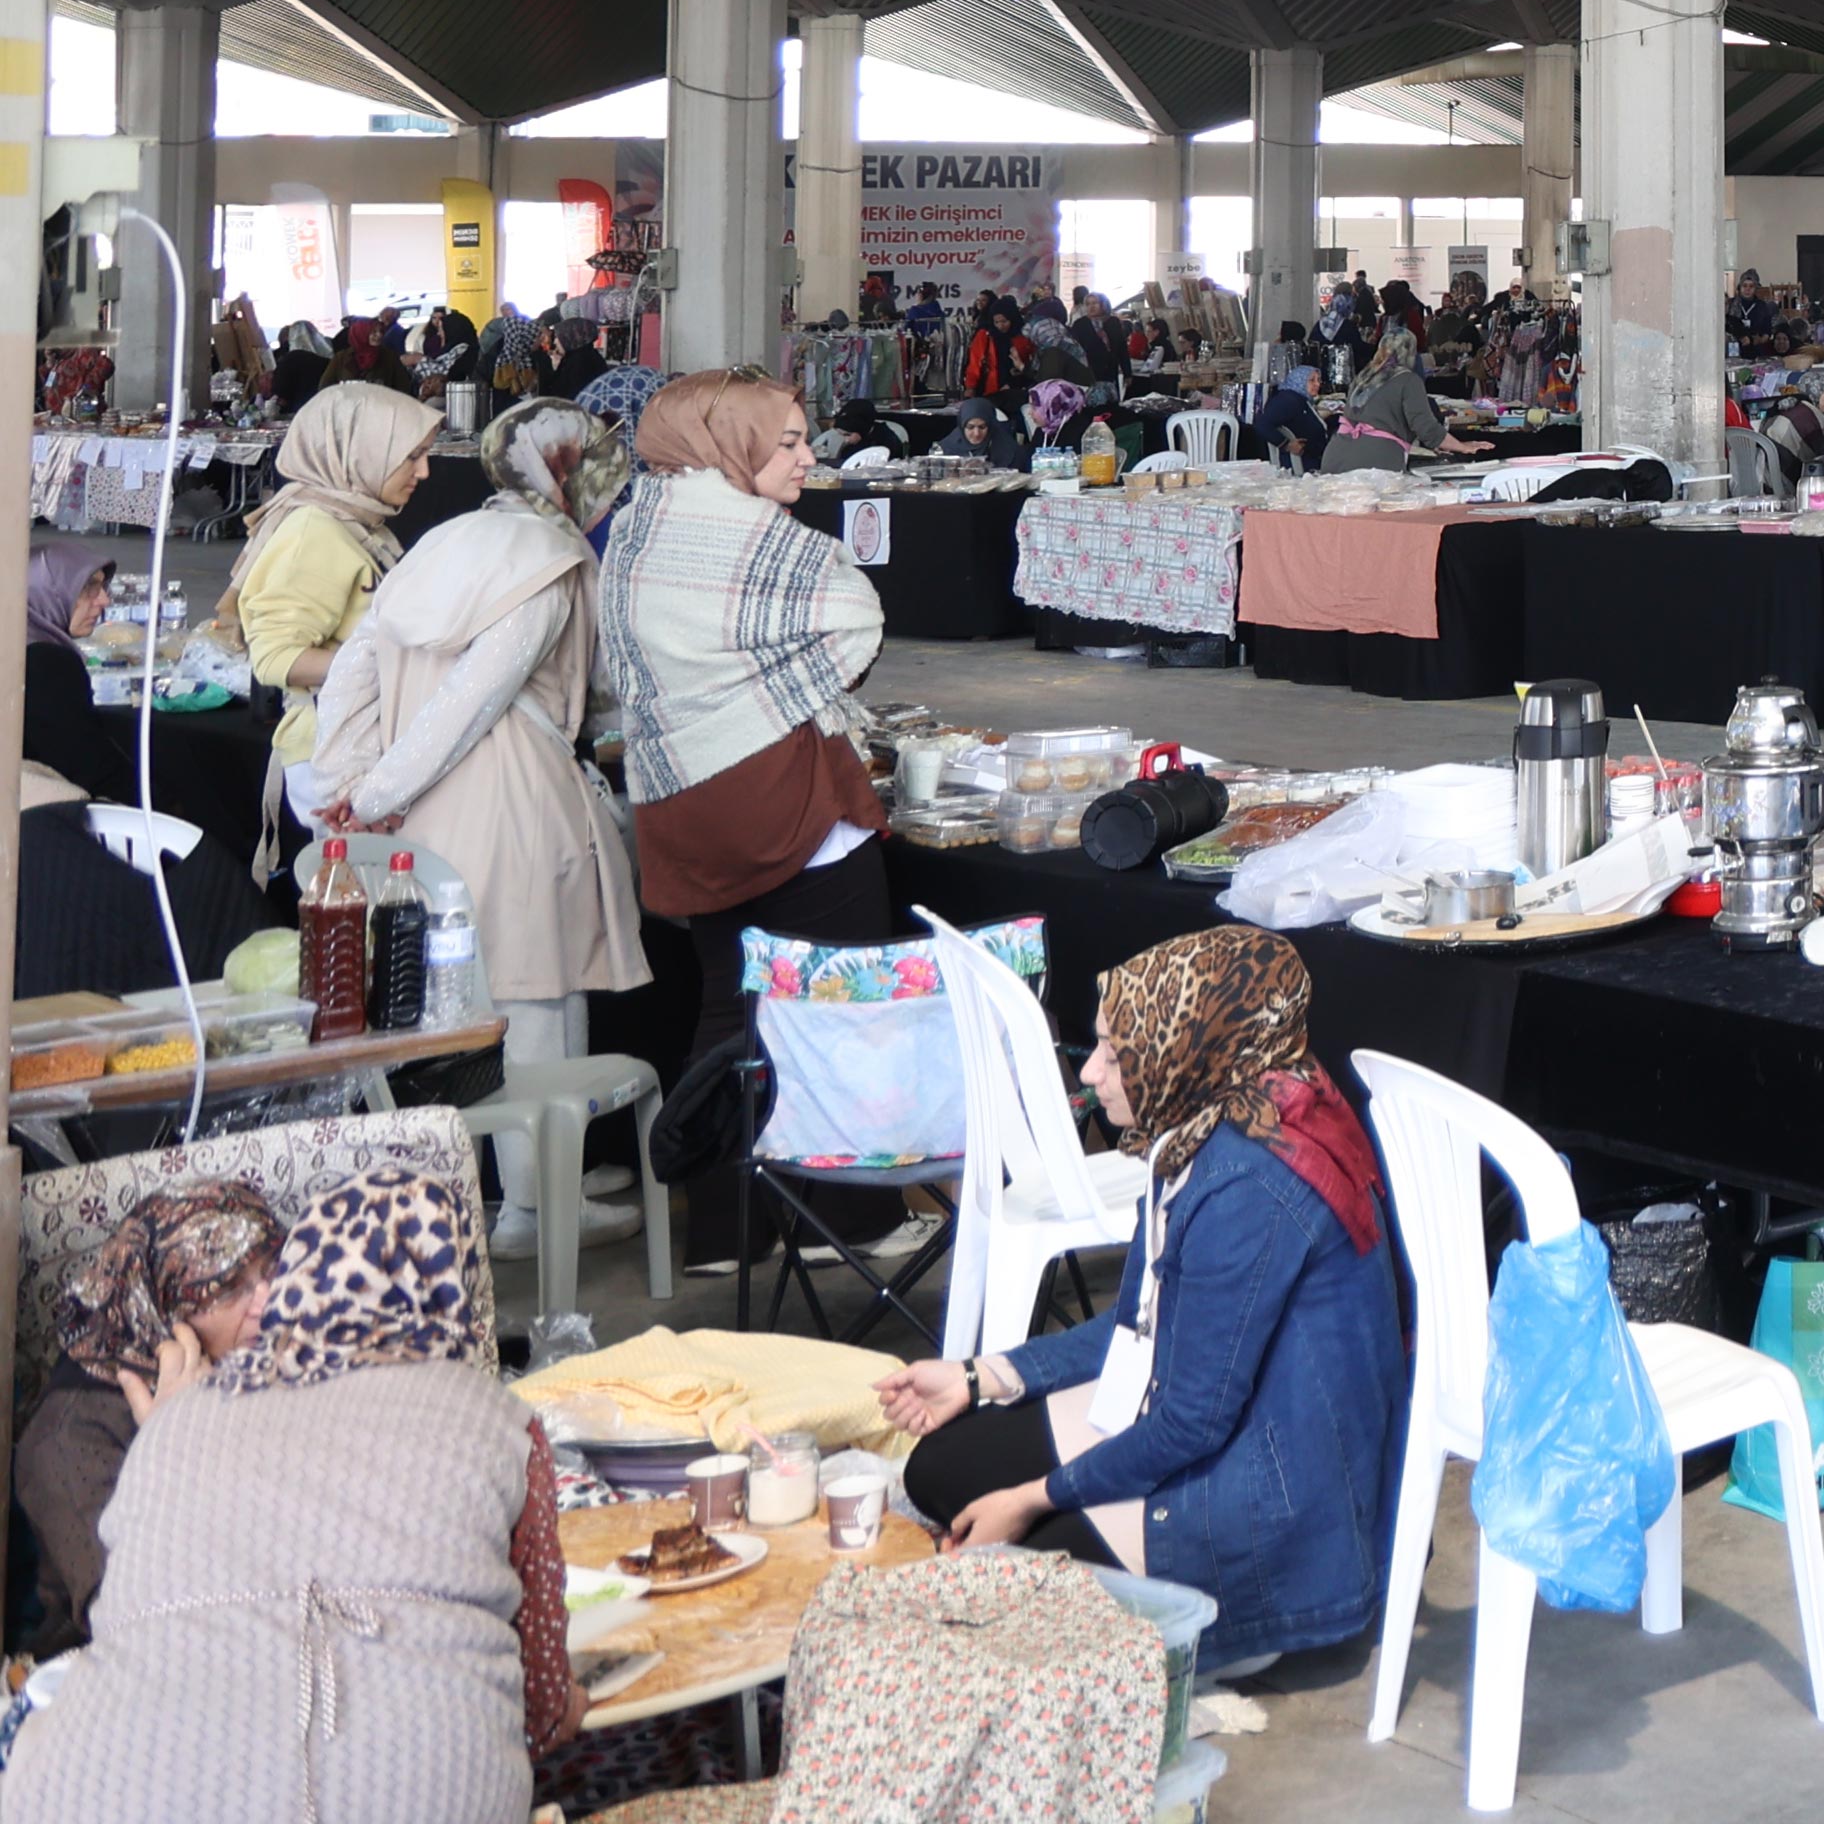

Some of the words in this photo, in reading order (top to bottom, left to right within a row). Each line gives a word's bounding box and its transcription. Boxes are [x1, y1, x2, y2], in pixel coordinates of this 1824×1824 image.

[916, 155, 1041, 188] PAZARI
[895, 204, 917, 221] ile
[920, 204, 1003, 225] Girişimci
[922, 225, 1025, 242] emeklerine
